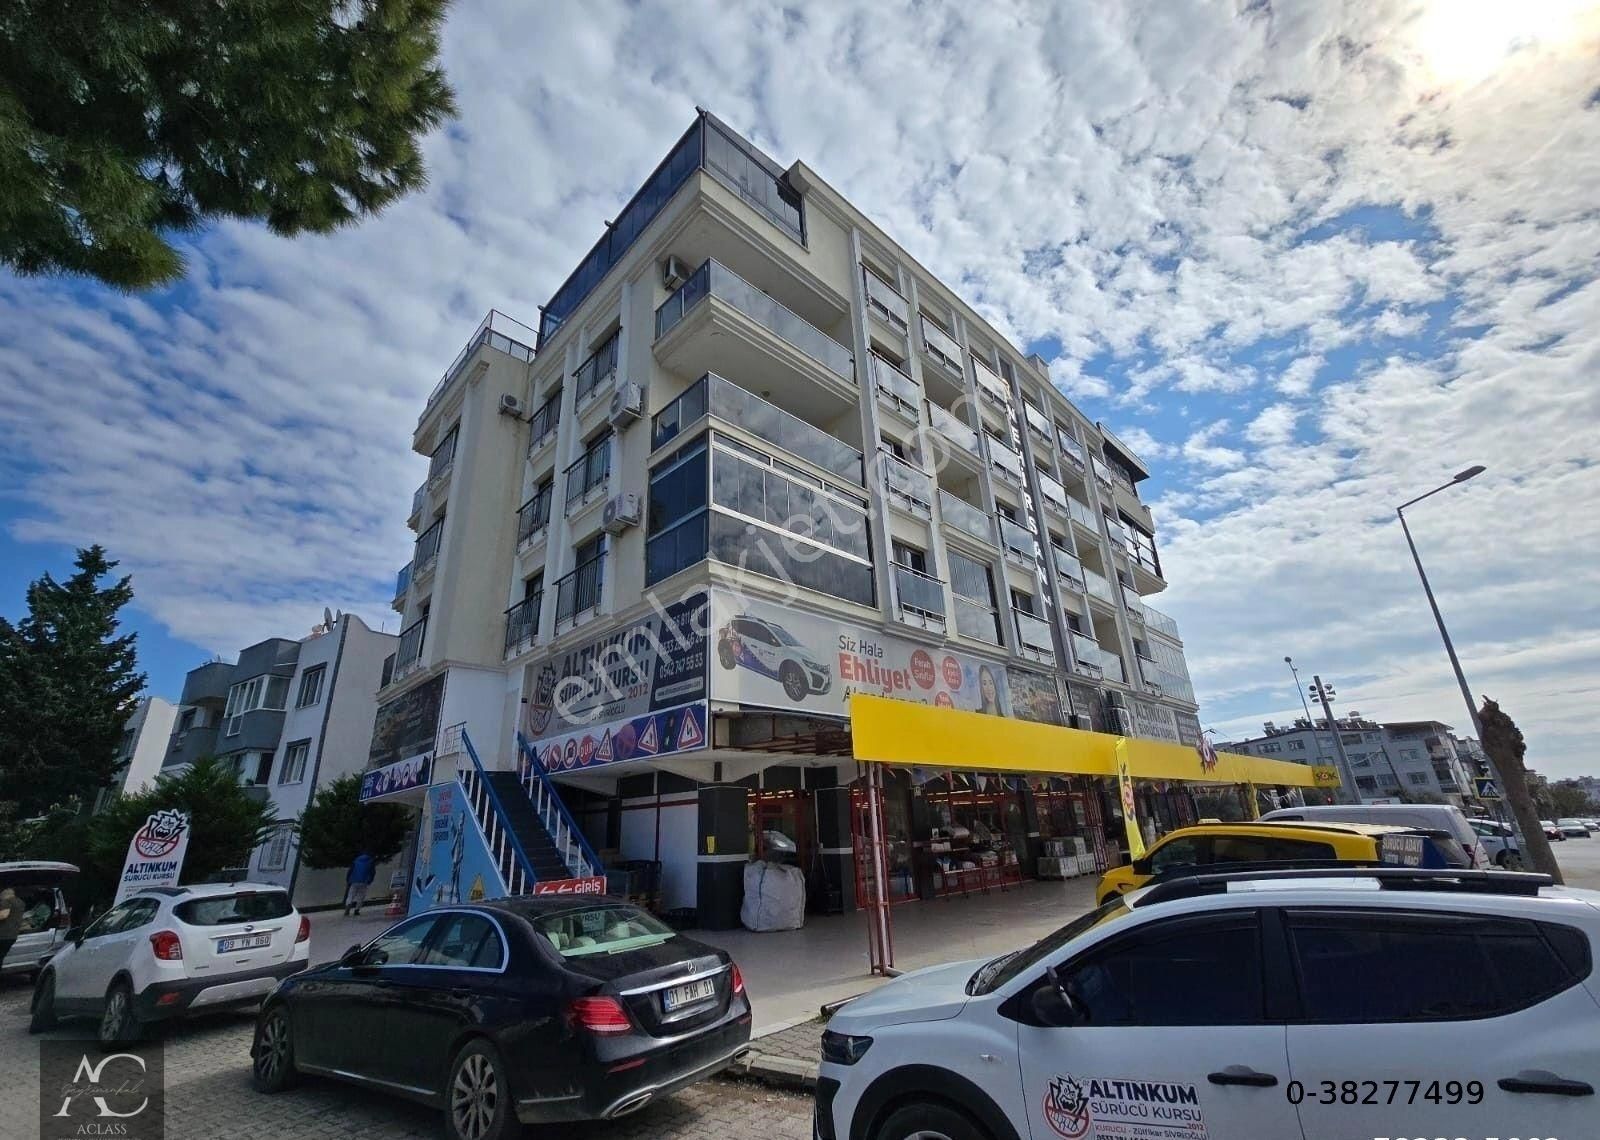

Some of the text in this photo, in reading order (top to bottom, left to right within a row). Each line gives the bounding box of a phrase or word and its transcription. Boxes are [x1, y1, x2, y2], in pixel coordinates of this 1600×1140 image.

[839, 635, 883, 658] Siz Hala
[839, 652, 911, 694] Ehliyet
[628, 682, 649, 699] 2012
[126, 861, 178, 875] ALTINKUM
[574, 879, 601, 895] GİRİŞ
[670, 990, 678, 1005] 01
[1089, 1079, 1200, 1105] ALTINKUM
[1091, 1100, 1202, 1122] SÜRÜCÜ KURSU
[1187, 1123, 1205, 1131] 2012
